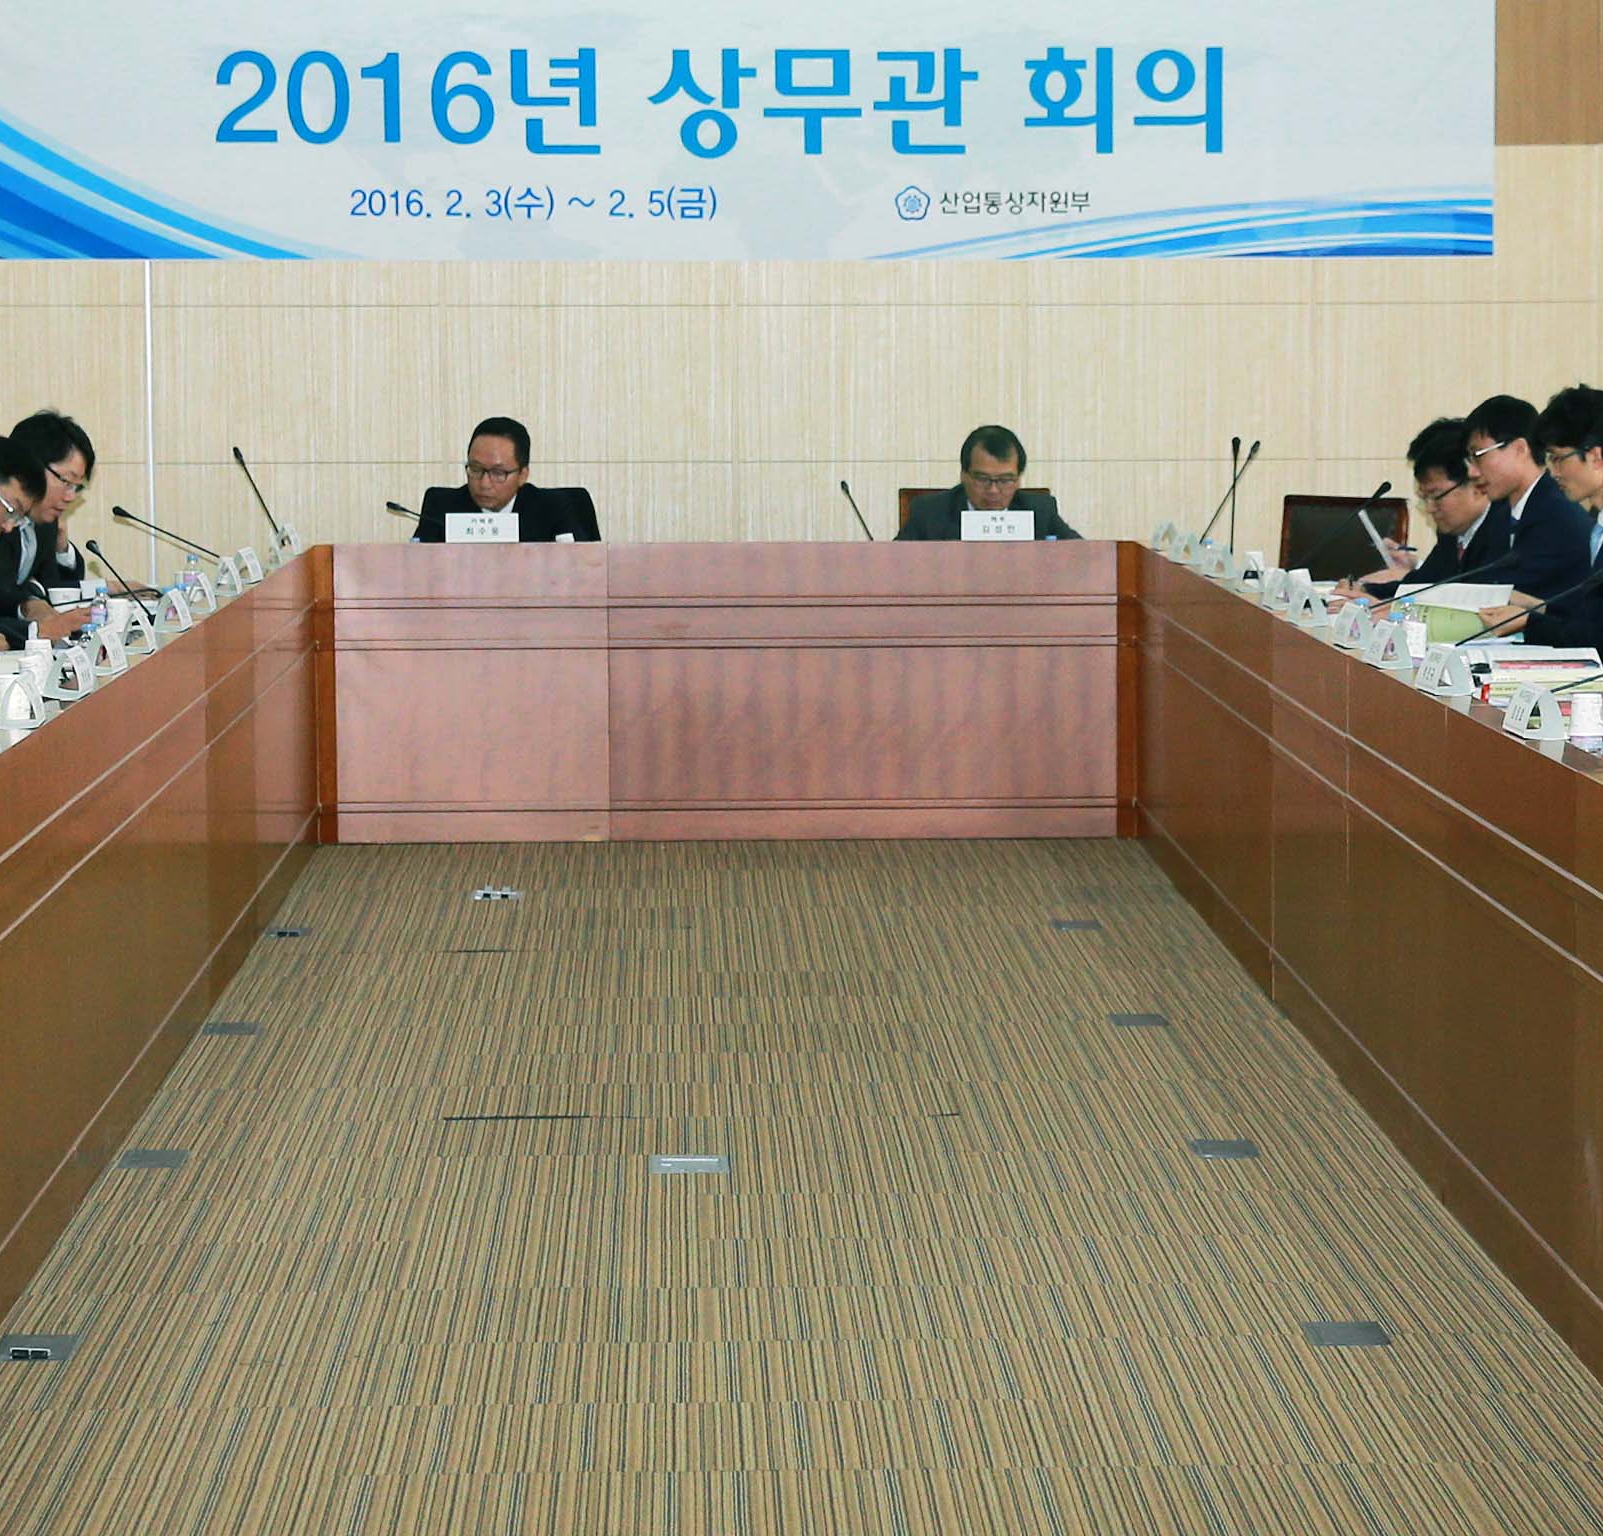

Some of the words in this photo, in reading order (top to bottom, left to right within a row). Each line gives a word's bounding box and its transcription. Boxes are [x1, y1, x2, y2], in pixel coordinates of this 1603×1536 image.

[215, 46, 603, 156] 2016년
[647, 47, 981, 160] 상무관
[1022, 45, 1225, 155] 회의
[349, 188, 433, 219] 2016.
[445, 188, 473, 219] 2.
[484, 186, 556, 220] 3(수)
[609, 188, 636, 219] 2.
[648, 186, 719, 220] 5(금)
[939, 191, 1090, 215] 산업통상자원부
